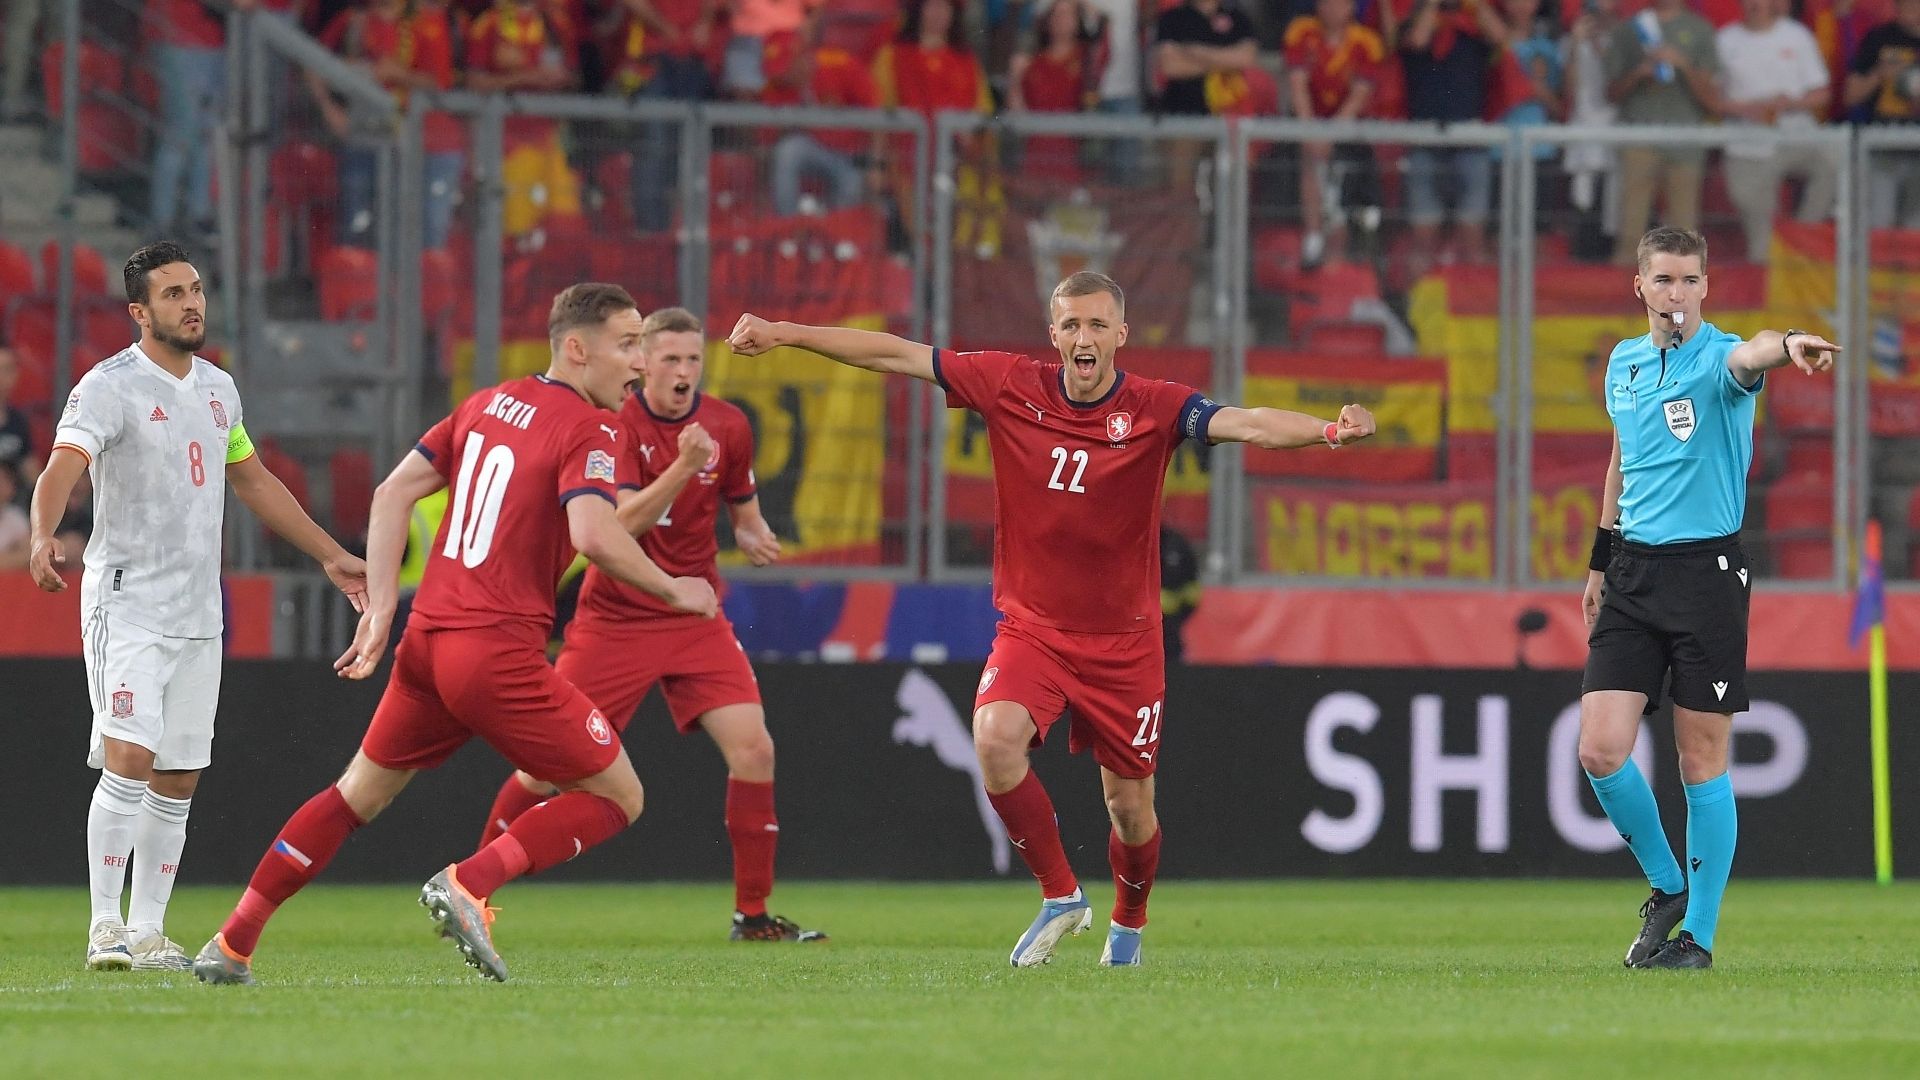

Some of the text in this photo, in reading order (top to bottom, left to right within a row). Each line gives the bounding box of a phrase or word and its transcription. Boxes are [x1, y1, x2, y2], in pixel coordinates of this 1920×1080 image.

[1188, 407, 1200, 437] ESPECT
[1669, 403, 1688, 414] UEFA
[188, 441, 206, 487] 8
[1048, 446, 1089, 494] 22
[442, 430, 515, 569] 10
[1132, 700, 1161, 746] 22
